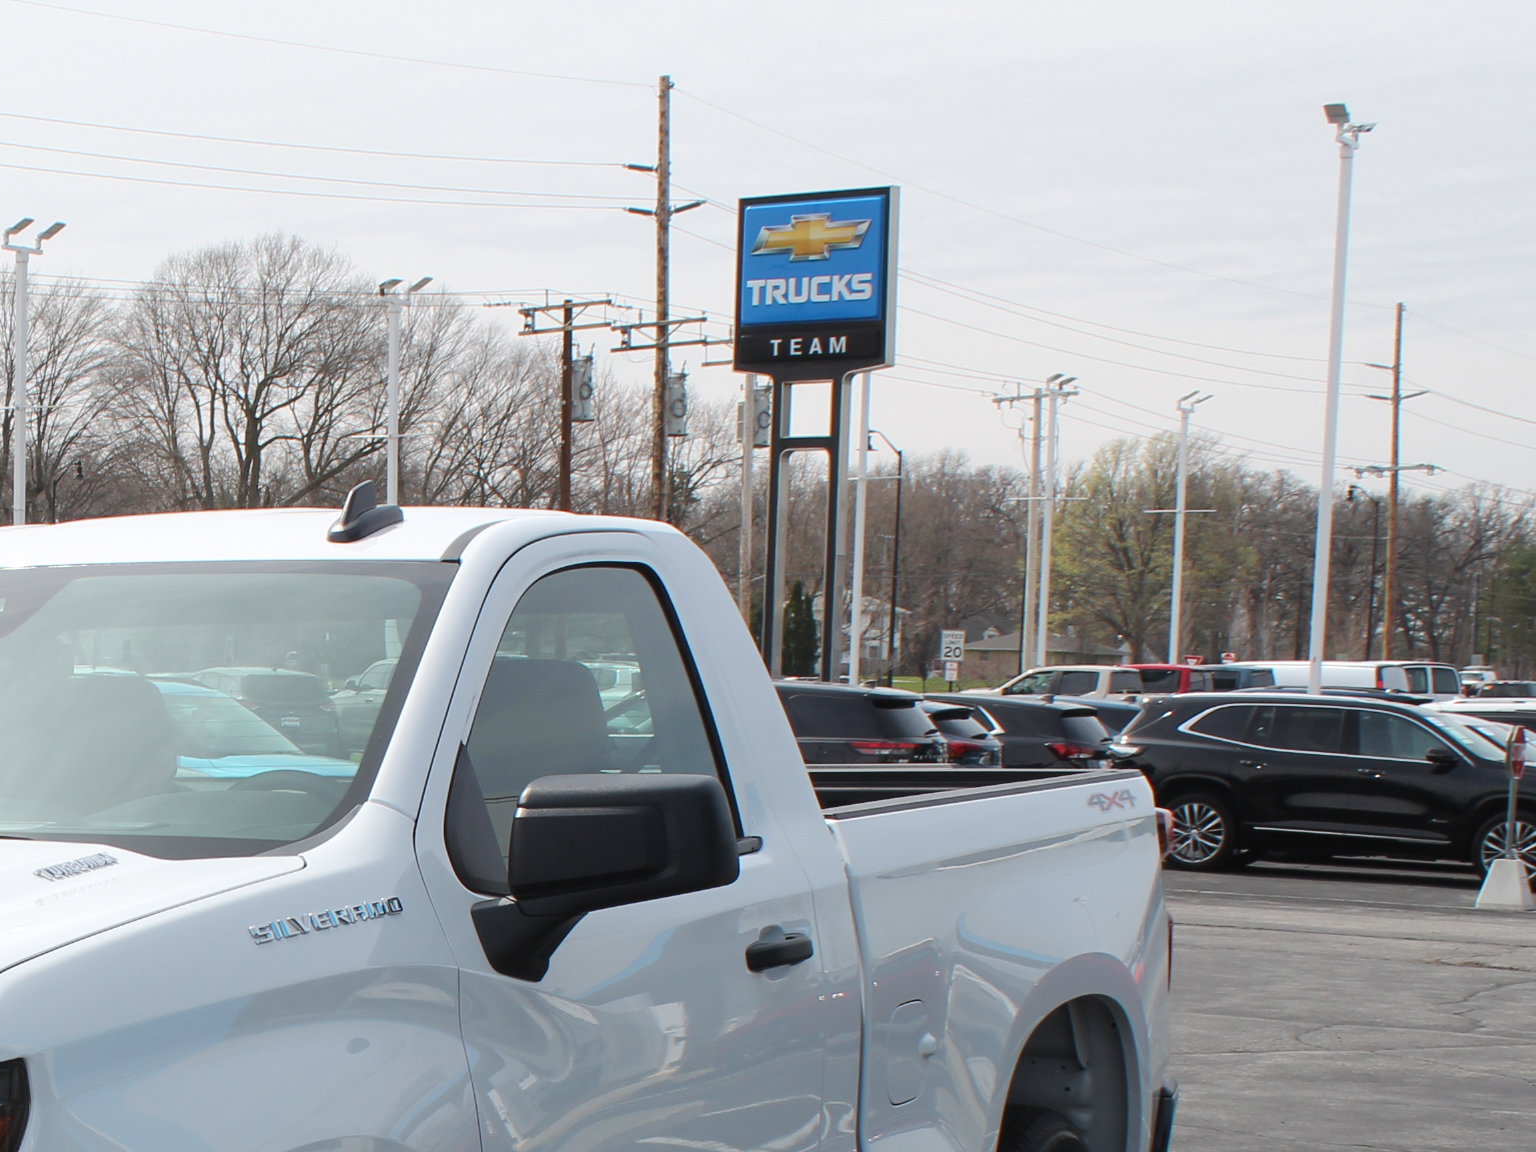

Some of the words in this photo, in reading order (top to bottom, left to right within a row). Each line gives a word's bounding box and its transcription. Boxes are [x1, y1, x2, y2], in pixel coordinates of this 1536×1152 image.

[747, 273, 873, 306] TRUCKS
[770, 336, 847, 356] TEAM
[944, 646, 962, 658] 20
[248, 896, 404, 945] SILVERADO
